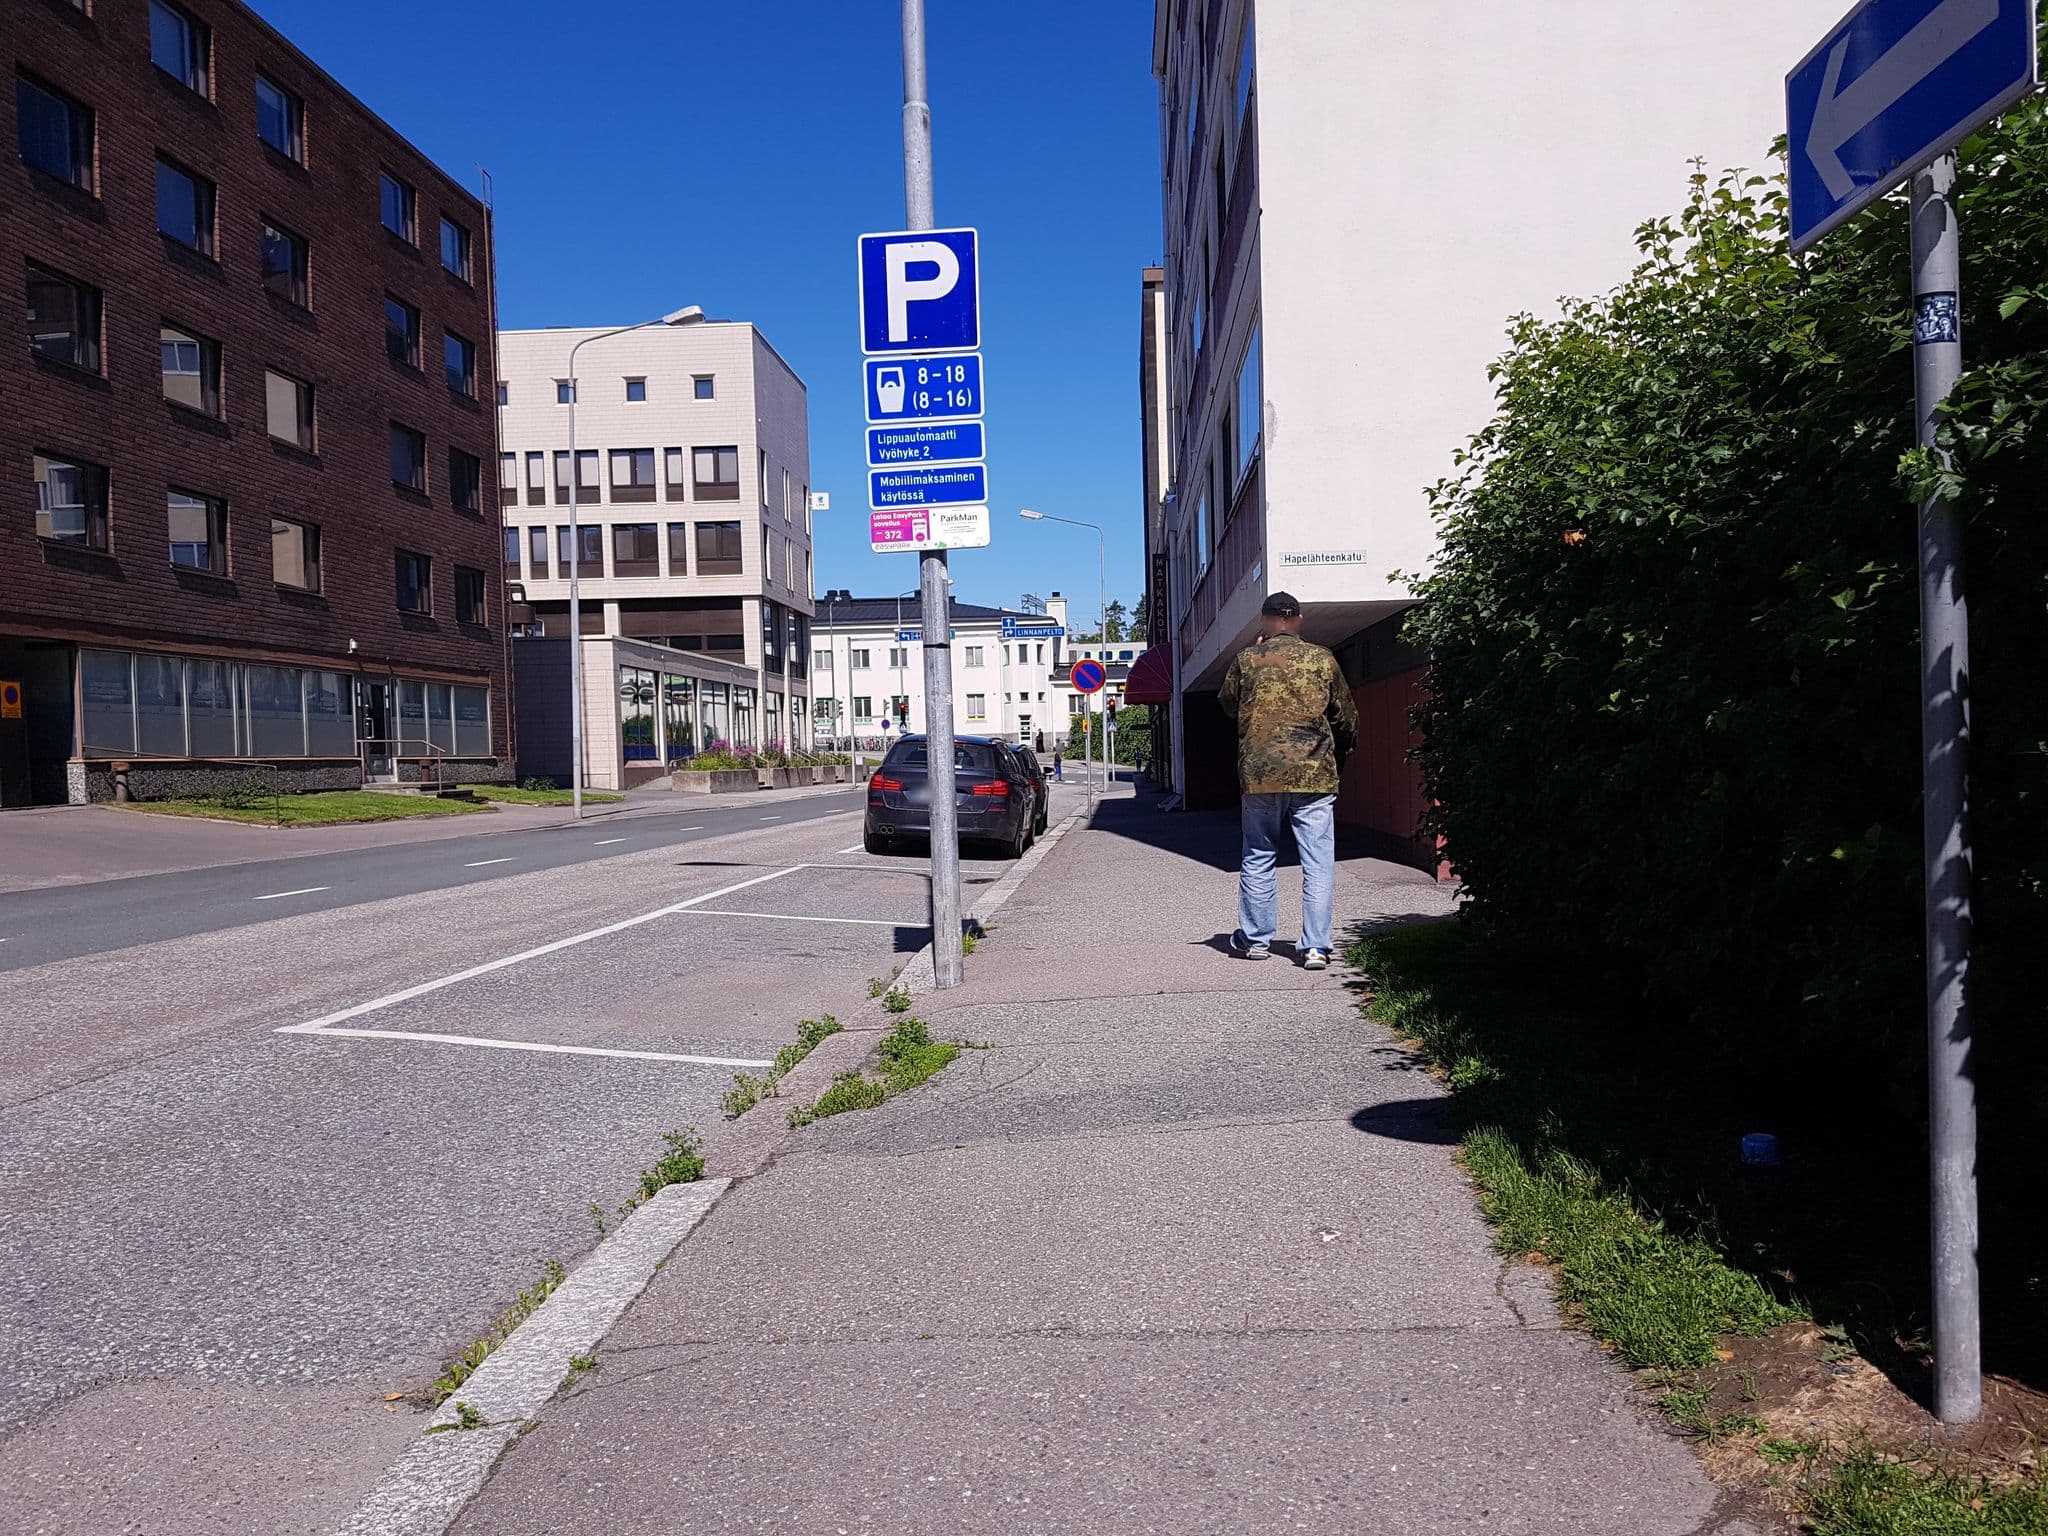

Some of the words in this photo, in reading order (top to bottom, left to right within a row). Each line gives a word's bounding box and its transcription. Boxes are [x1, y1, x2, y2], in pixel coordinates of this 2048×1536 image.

[885, 241, 960, 343] P
[877, 429, 957, 445] Lippuautomaatti
[879, 447, 920, 460] Vyöhyke
[923, 446, 930, 457] 2
[880, 472, 975, 487] Mobiilimaksaminen
[881, 489, 924, 503] käytössä
[940, 513, 978, 522] ParkMan
[884, 530, 902, 539] 372
[1284, 552, 1362, 565] Hapelähteenkatu
[1017, 628, 1063, 636] LINNANPELTO
